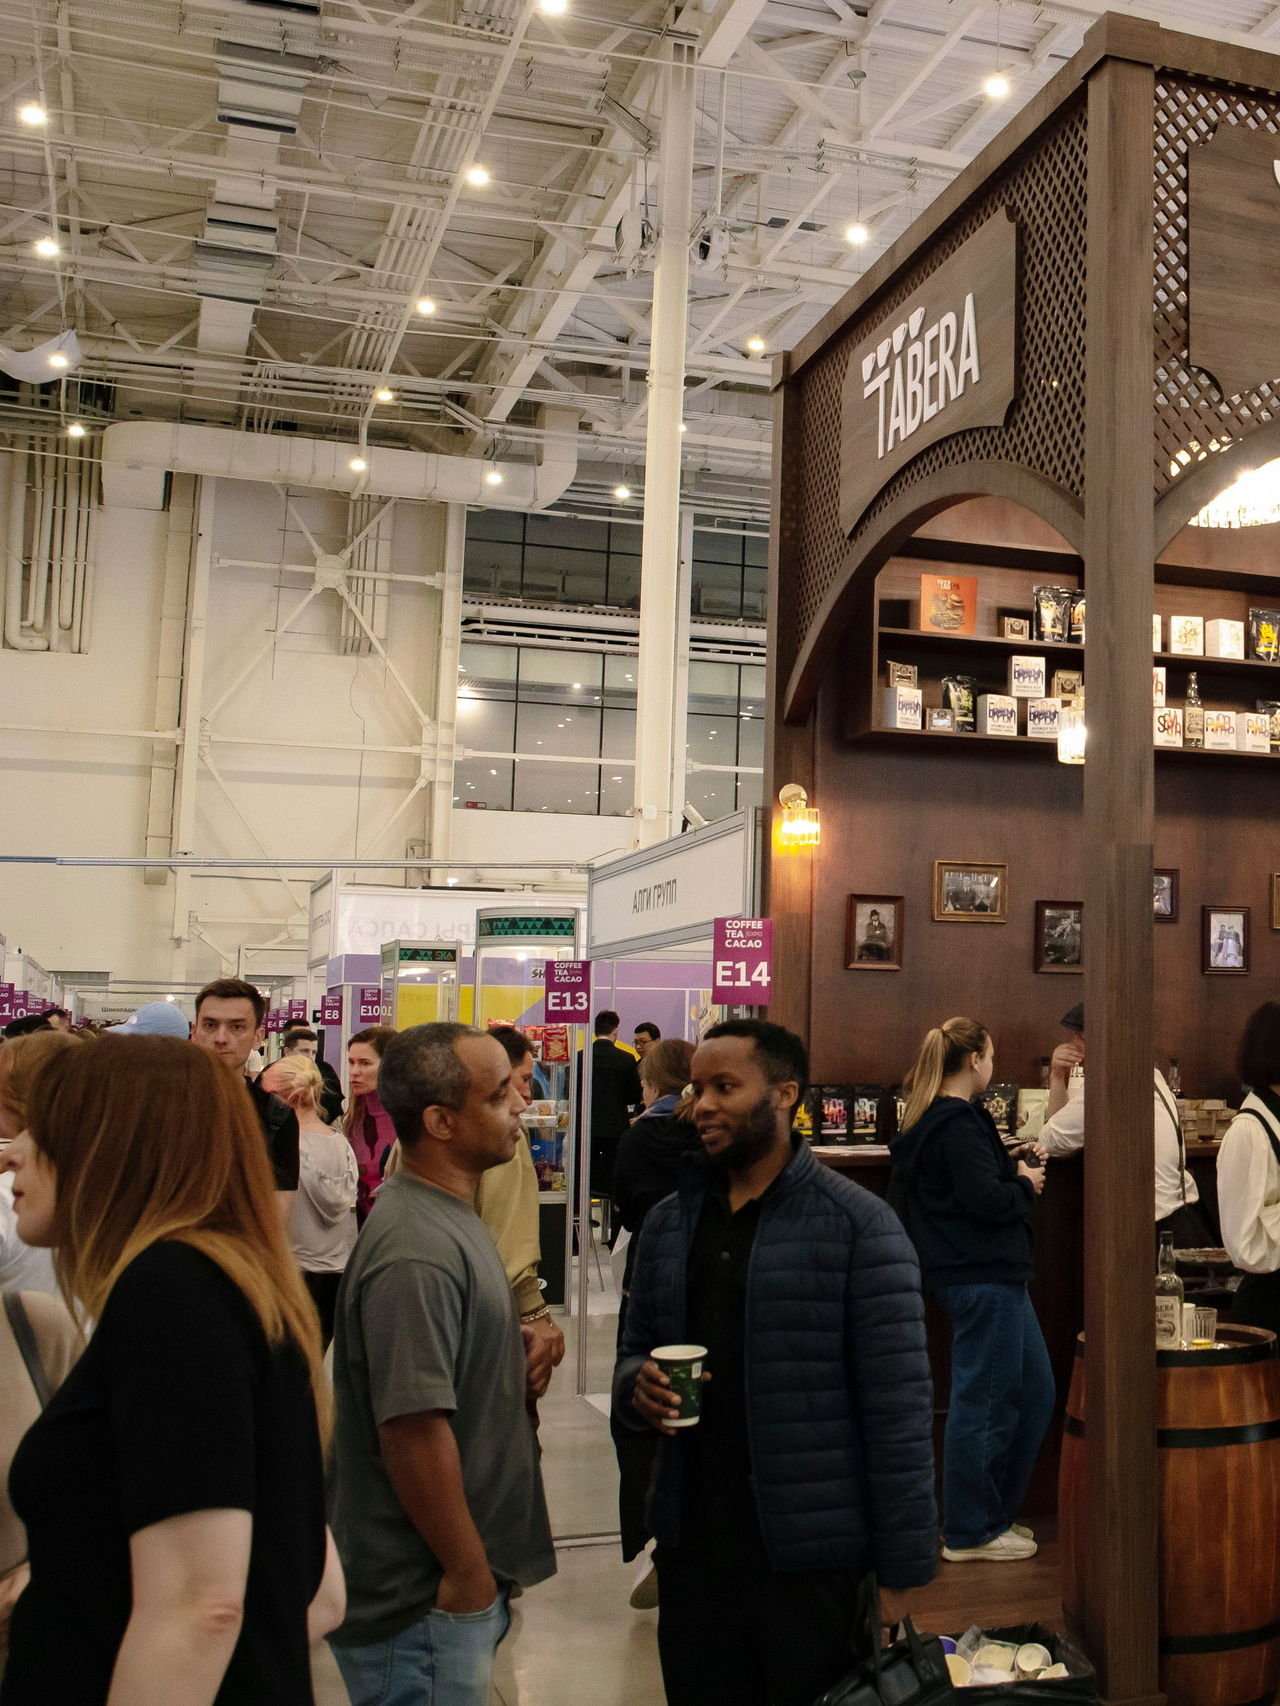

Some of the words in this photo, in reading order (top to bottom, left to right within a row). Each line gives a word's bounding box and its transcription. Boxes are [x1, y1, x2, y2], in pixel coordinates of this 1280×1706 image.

[864, 292, 980, 460] TABERA
[632, 886, 652, 915] АЛГИ
[652, 878, 677, 910] ГРУПП
[725, 920, 763, 929] COFFEE
[725, 930, 744, 939] TEA
[725, 939, 763, 948] CACAO
[435, 950, 454, 961] SKA
[716, 961, 771, 987] E14
[548, 991, 588, 1011] E13
[292, 1011, 304, 1019] E7
[325, 1010, 340, 1020] E8
[360, 1005, 380, 1016] E10
